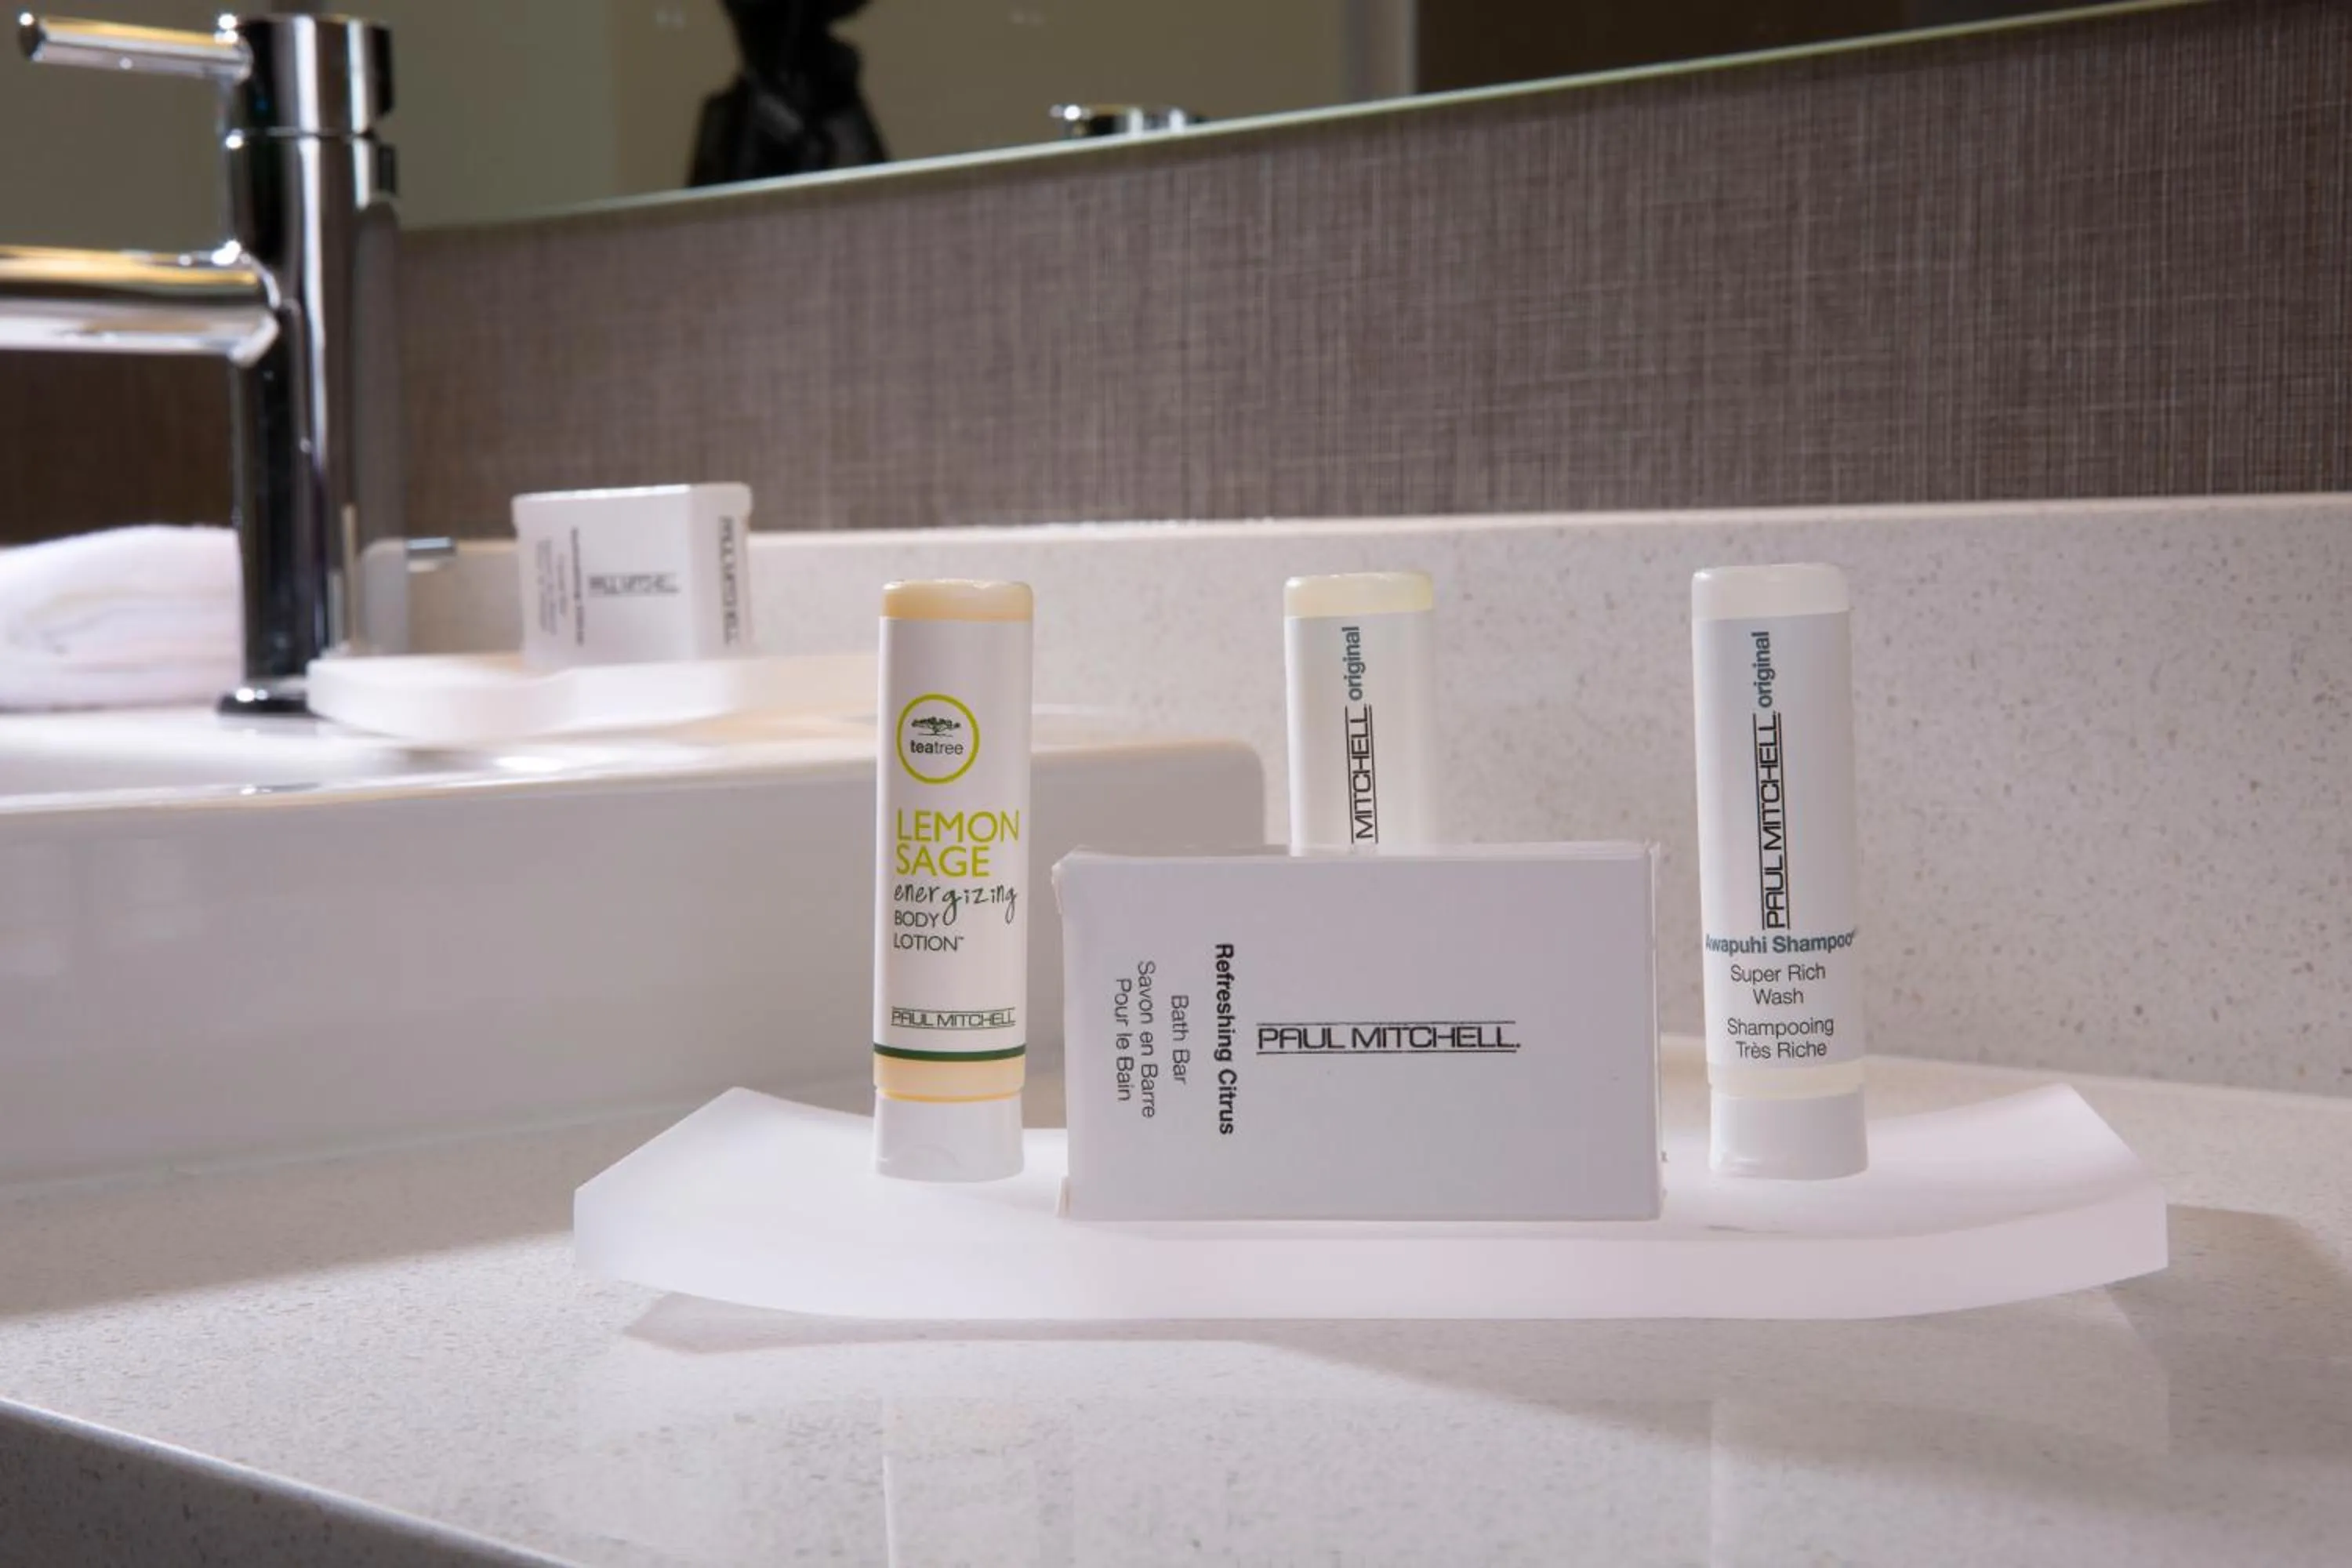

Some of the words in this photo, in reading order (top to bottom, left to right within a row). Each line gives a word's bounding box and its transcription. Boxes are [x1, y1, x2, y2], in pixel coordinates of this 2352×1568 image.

[1341, 626, 1367, 701] original
[1751, 631, 1776, 708] original
[909, 739, 964, 755] teatree
[1349, 703, 1374, 839] MITCHELL
[897, 808, 1019, 843] LEMON
[895, 842, 990, 877] SAGE
[893, 883, 1018, 925] energizing
[1764, 855, 1785, 929] PAUL
[894, 909, 940, 928] BODY
[1730, 964, 1781, 985] Super
[1788, 962, 1827, 981] Rich
[1113, 978, 1133, 1026] Pour
[1138, 960, 1156, 1025] Savon
[1214, 943, 1236, 1062] Refreshing
[1752, 987, 1805, 1006] Wash
[891, 1009, 933, 1026] PAUL
[1171, 994, 1189, 1042] Bath
[1727, 1017, 1835, 1039] Shampooing
[1116, 1033, 1133, 1050] le
[1140, 1031, 1155, 1056] en
[1258, 1026, 1345, 1050] PAUL
[1736, 1040, 1771, 1059] Très
[1777, 1040, 1828, 1058] Riche
[1116, 1056, 1135, 1102] Bain
[1172, 1049, 1191, 1085] Bar
[1141, 1063, 1159, 1119] Barre
[1218, 1069, 1238, 1135] Citrus
